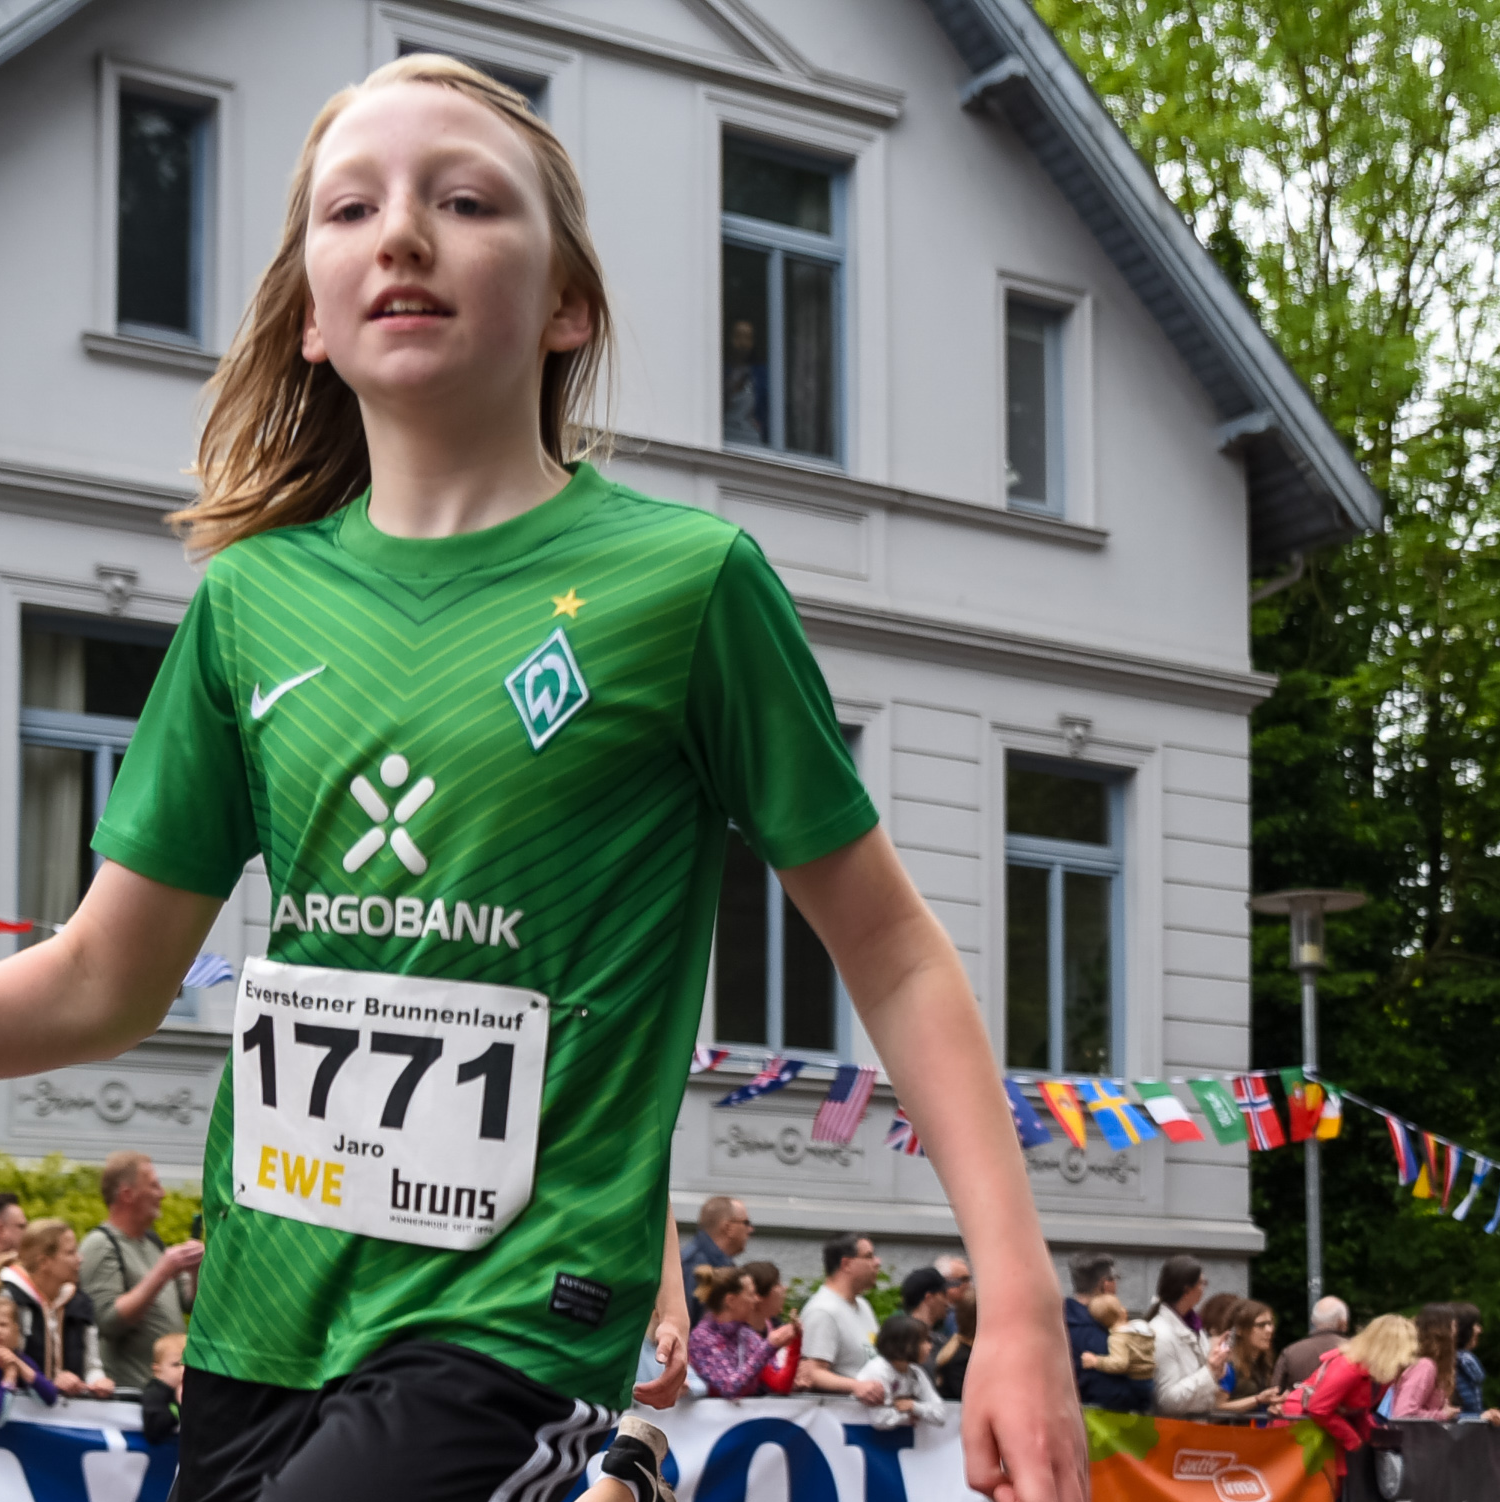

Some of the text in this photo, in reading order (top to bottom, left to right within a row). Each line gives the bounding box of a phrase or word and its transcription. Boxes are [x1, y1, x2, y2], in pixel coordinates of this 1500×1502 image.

[246, 980, 525, 1031] Everstener Brunnenlauf
[243, 1013, 515, 1141] 1771
[333, 1134, 385, 1158] Jaro
[257, 1144, 497, 1221] EWE bruns
